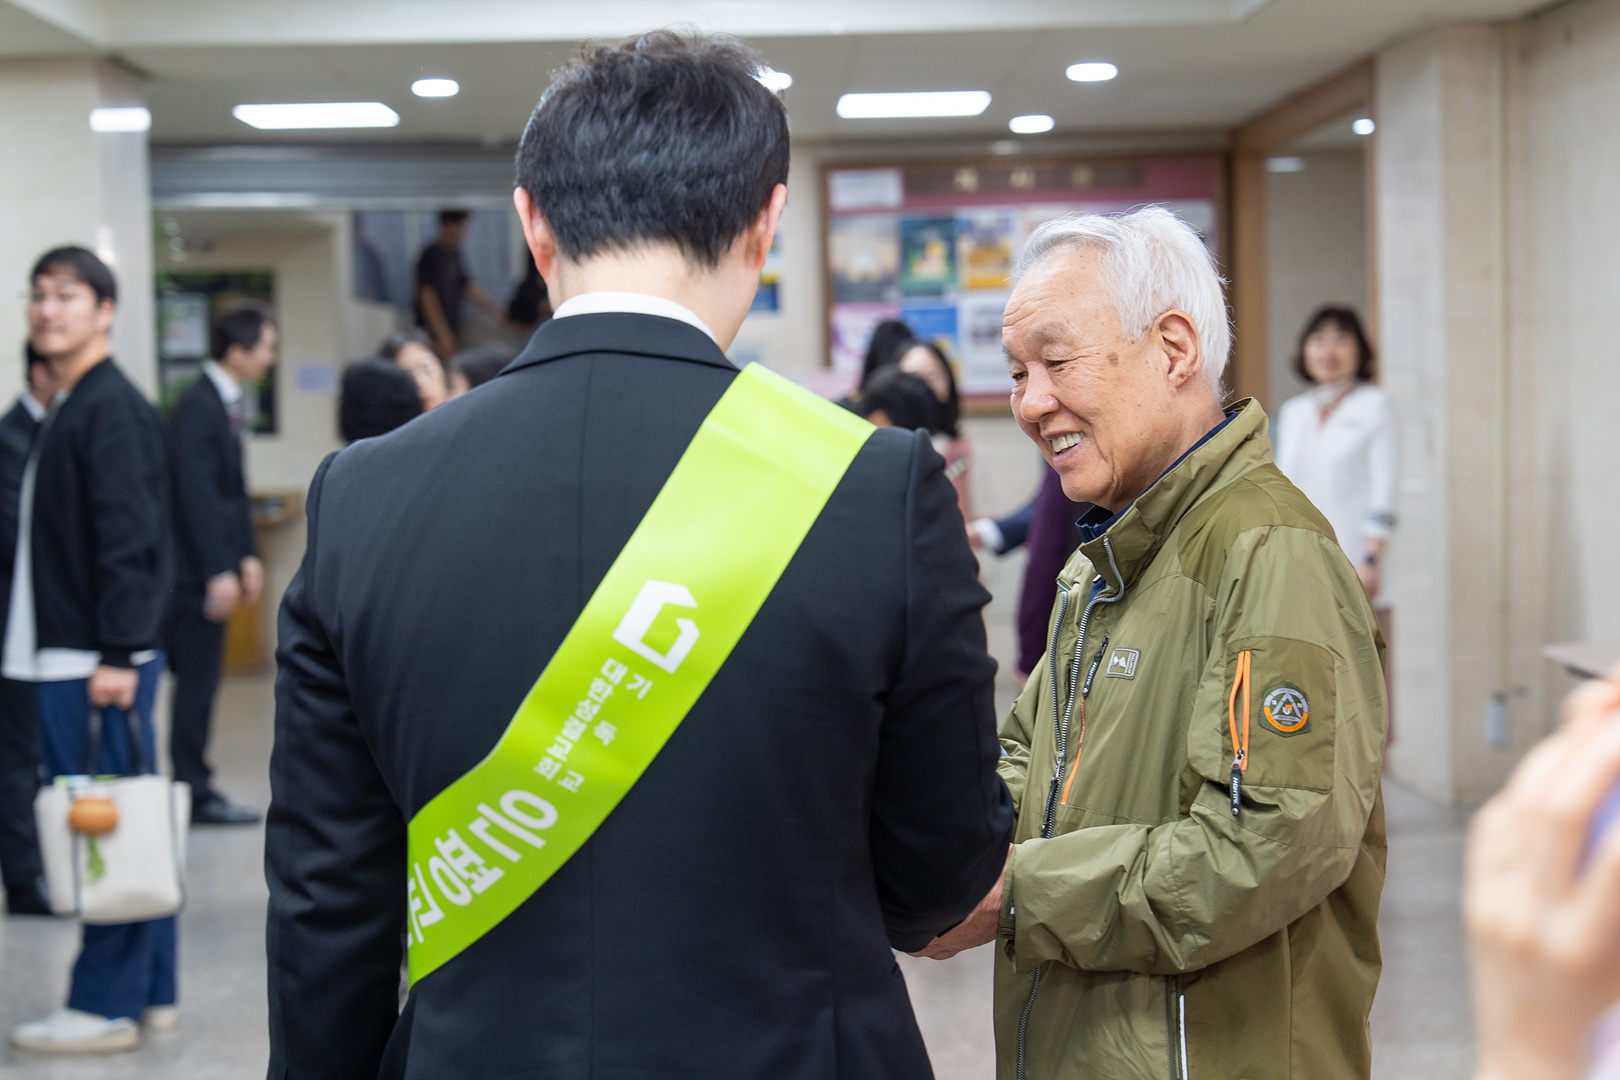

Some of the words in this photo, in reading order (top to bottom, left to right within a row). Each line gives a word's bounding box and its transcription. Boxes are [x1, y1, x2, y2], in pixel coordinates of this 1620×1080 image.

[532, 657, 629, 781] 대한성결교회
[557, 671, 654, 794] 기독교
[407, 789, 558, 947] 은평교
